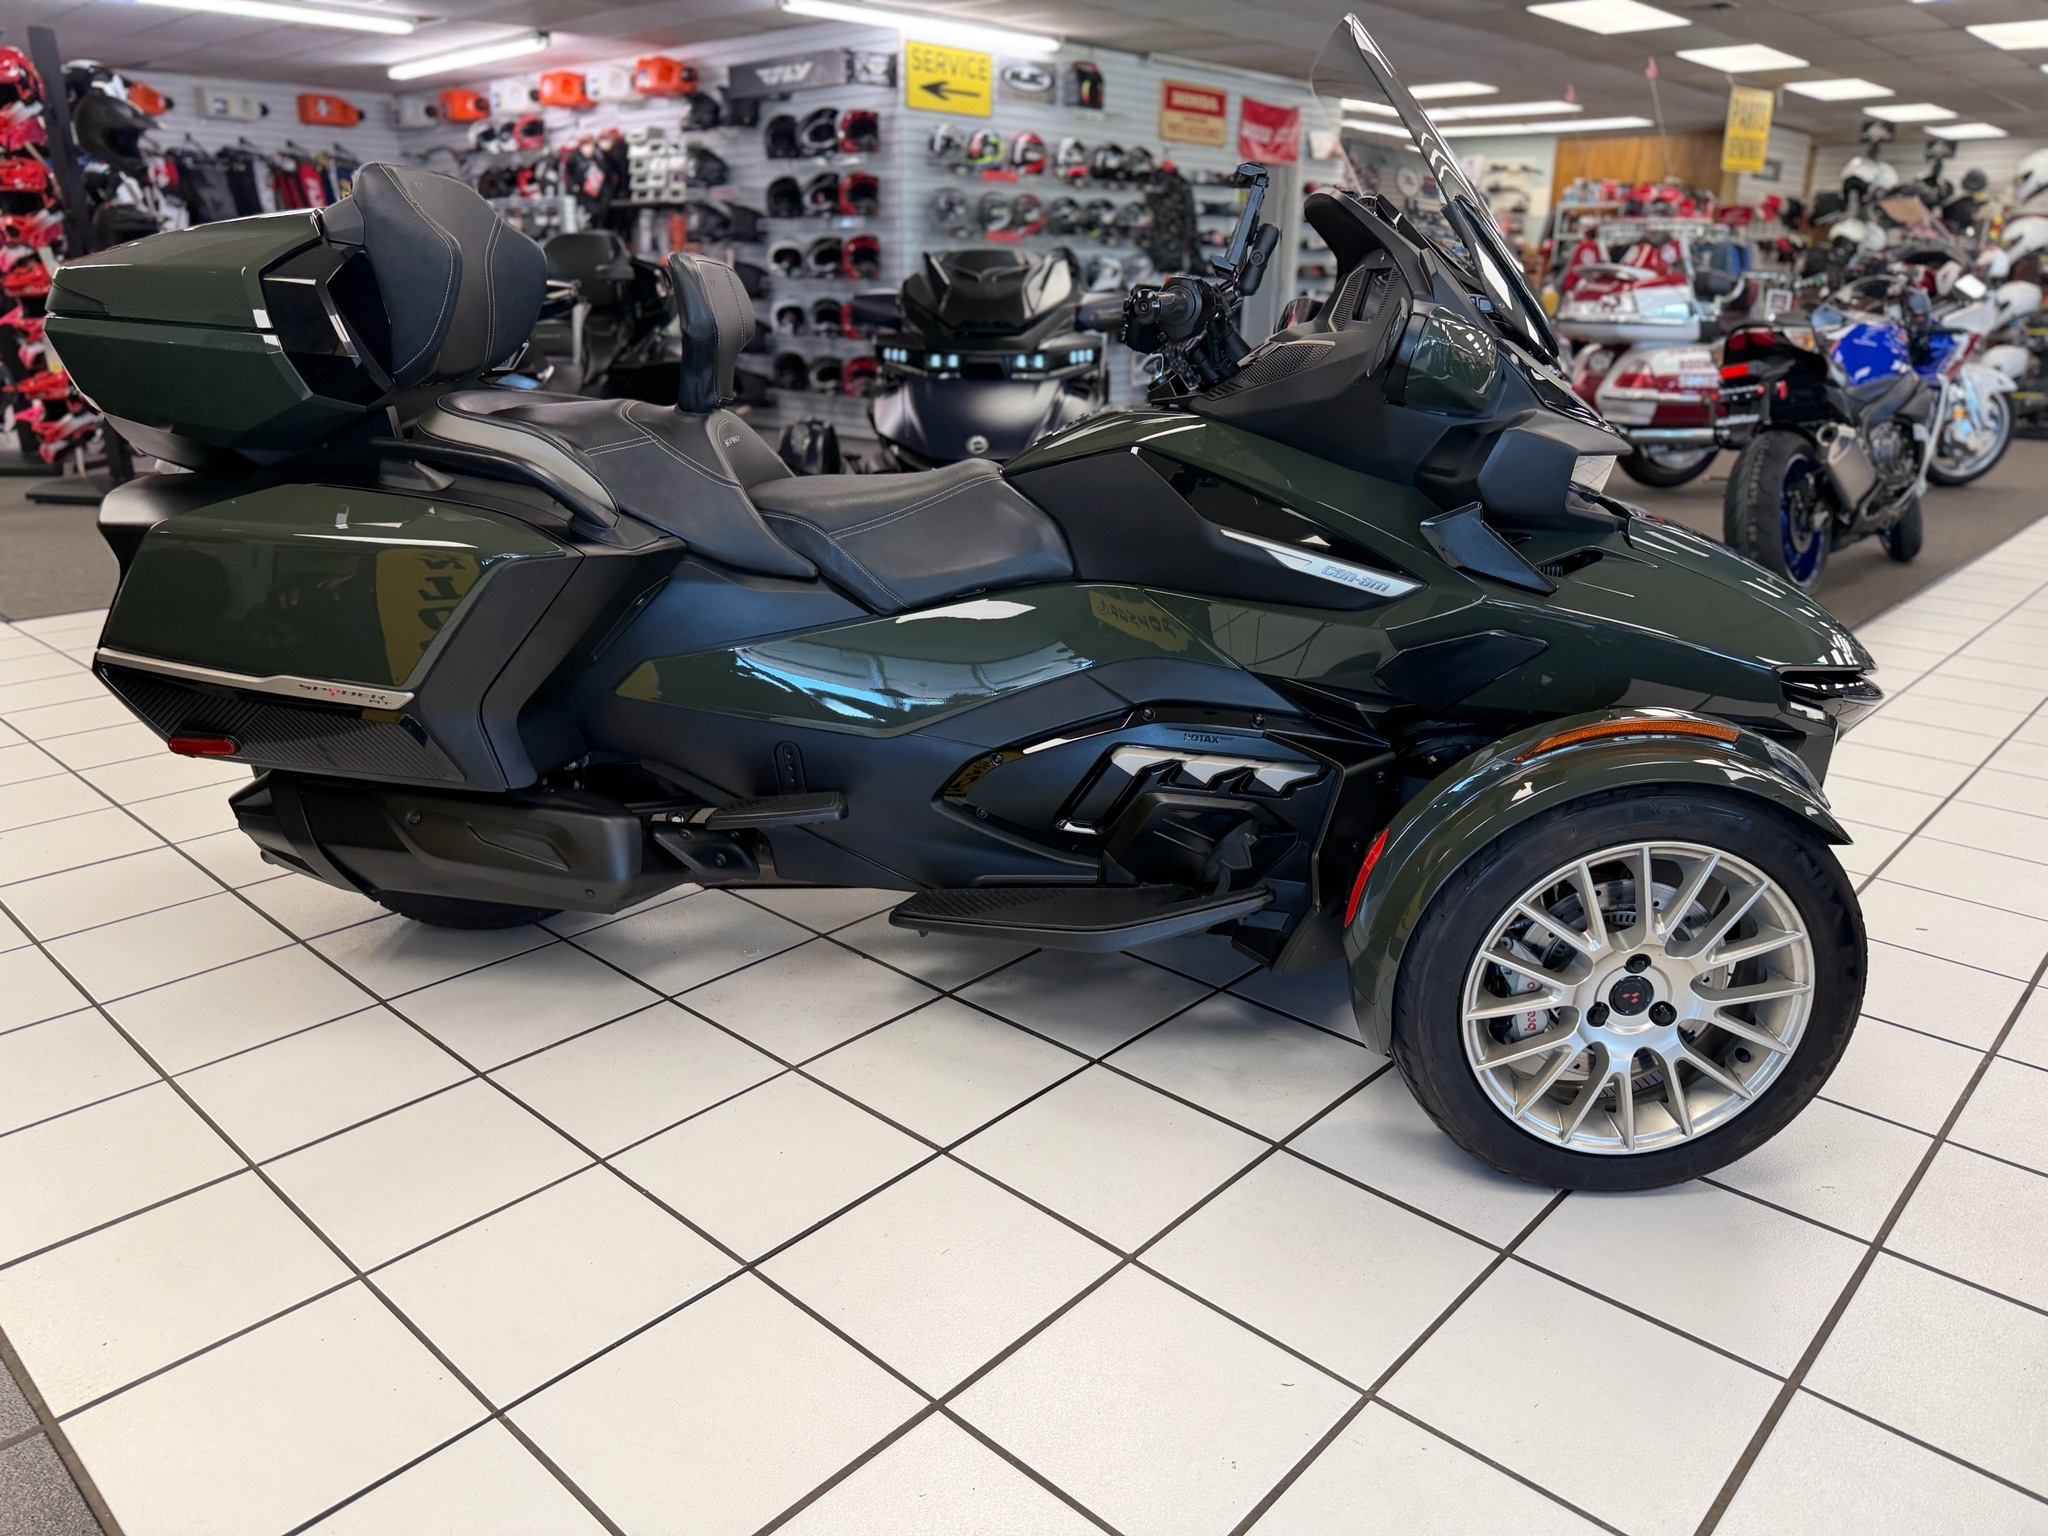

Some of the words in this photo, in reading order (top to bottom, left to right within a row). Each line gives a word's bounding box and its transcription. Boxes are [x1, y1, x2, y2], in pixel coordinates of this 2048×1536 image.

[910, 47, 988, 82] SERVICE
[1170, 89, 1220, 113] HONDA
[1321, 565, 1390, 593] can-am
[1183, 732, 1219, 744] ROTAX
[1524, 981, 1537, 1032] breo
